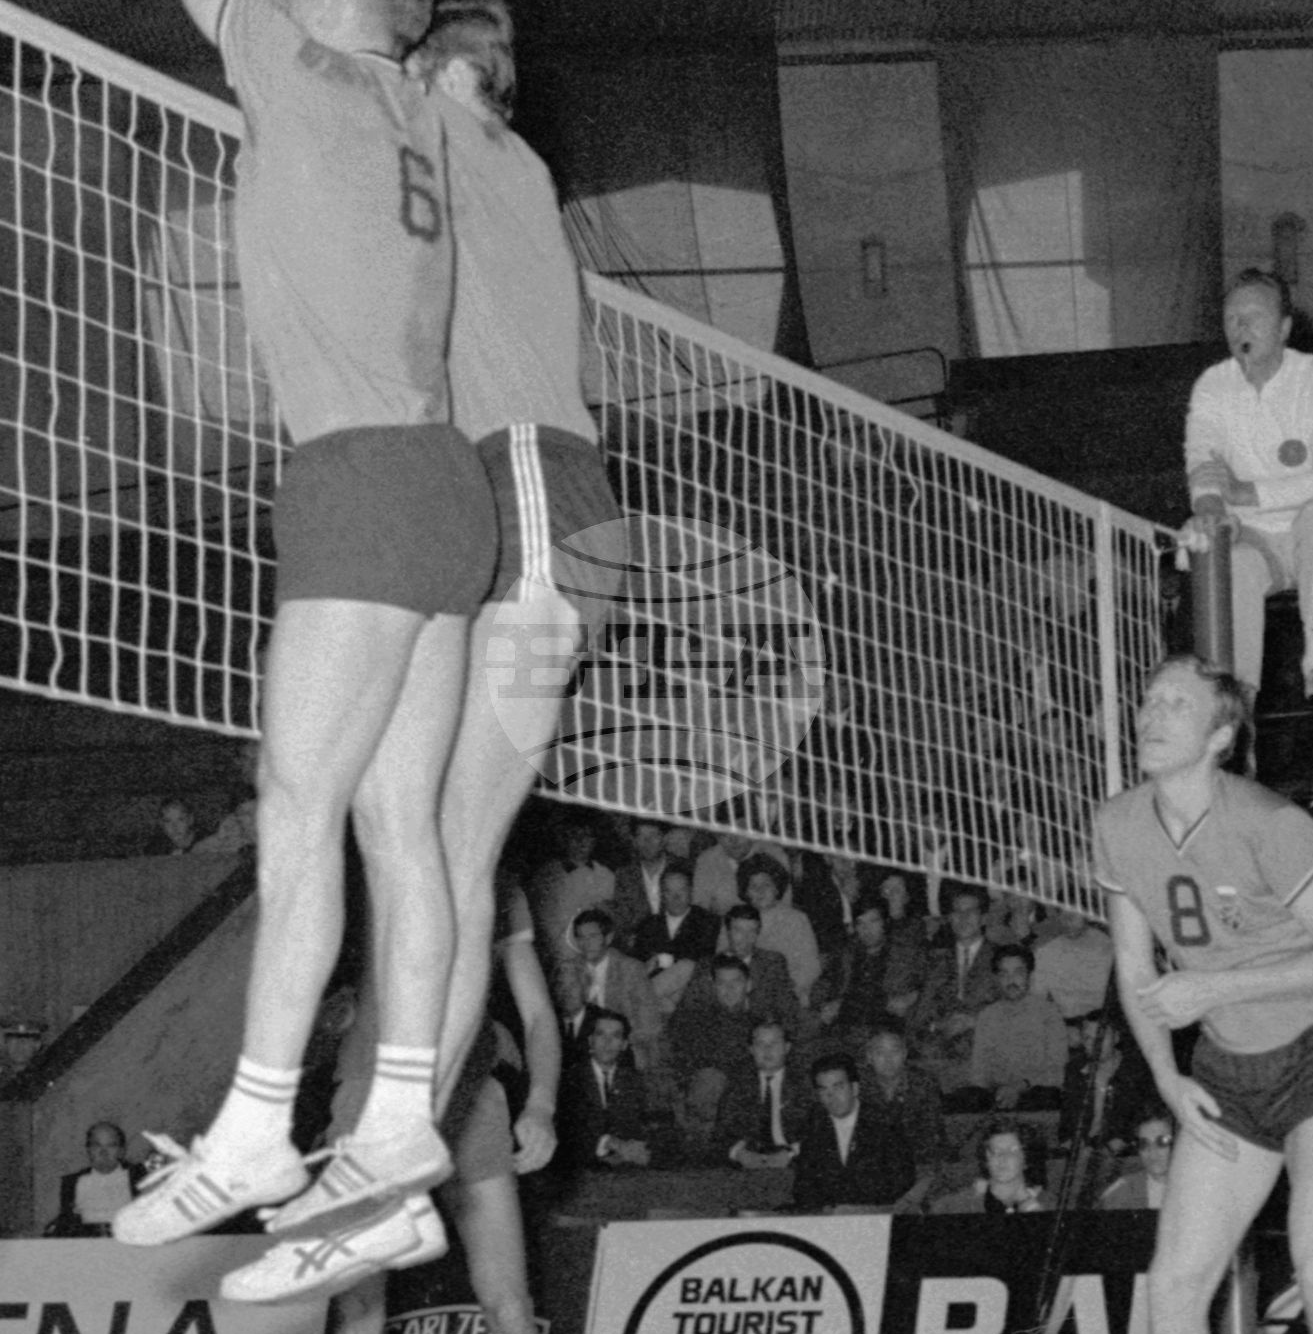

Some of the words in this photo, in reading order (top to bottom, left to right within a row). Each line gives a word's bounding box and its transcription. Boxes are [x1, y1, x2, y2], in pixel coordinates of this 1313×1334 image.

[397, 146, 442, 244] 6
[1167, 874, 1212, 947] 8
[680, 1276, 824, 1304] BALKAN
